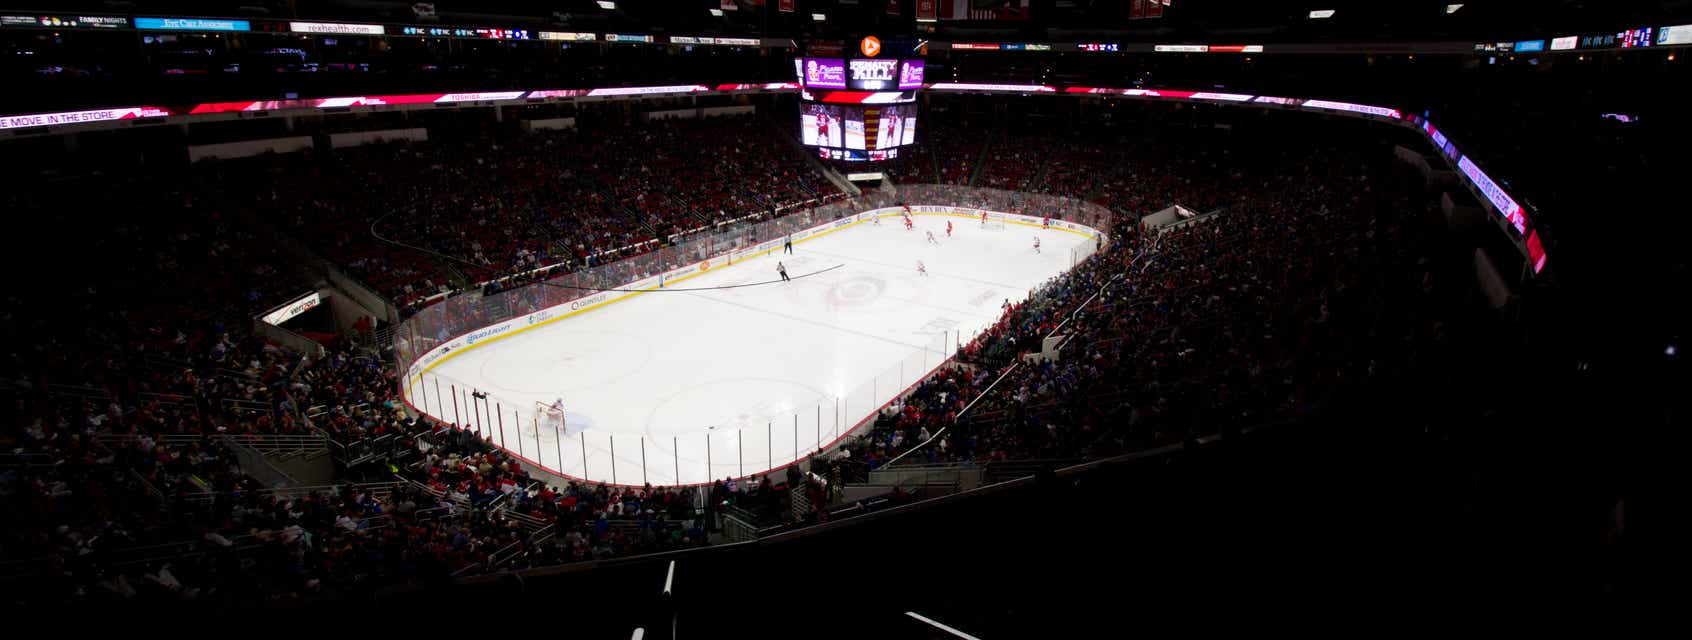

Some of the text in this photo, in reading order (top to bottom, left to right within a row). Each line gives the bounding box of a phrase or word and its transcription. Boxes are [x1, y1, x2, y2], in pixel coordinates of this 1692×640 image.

[308, 24, 369, 34] rexhealth.com
[853, 68, 893, 80] KILL
[60, 113, 80, 122] THE
